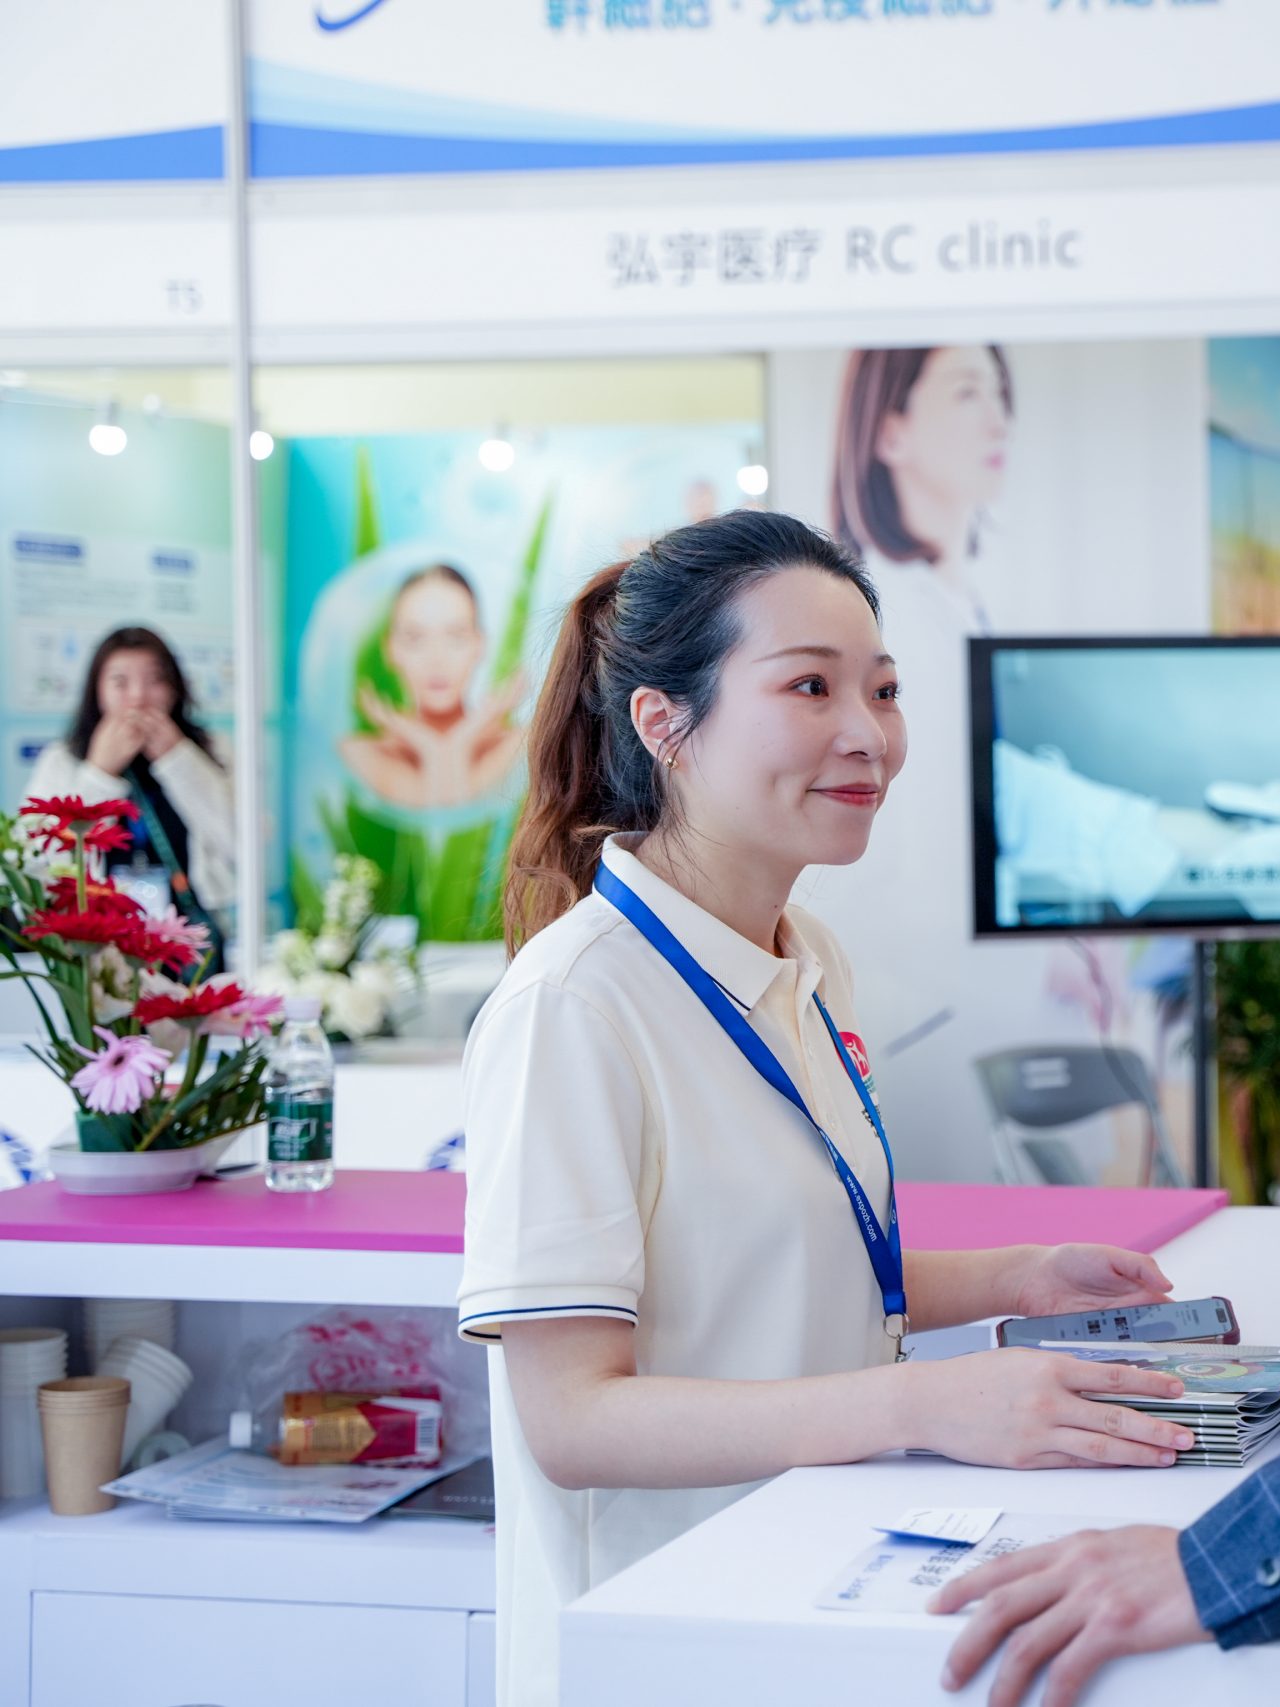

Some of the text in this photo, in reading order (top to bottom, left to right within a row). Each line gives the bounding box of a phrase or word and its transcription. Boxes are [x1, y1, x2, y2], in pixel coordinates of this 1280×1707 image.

[845, 223, 917, 276] RC
[938, 219, 1083, 273] clinic
[846, 1175, 878, 1242] www.expozh.com
